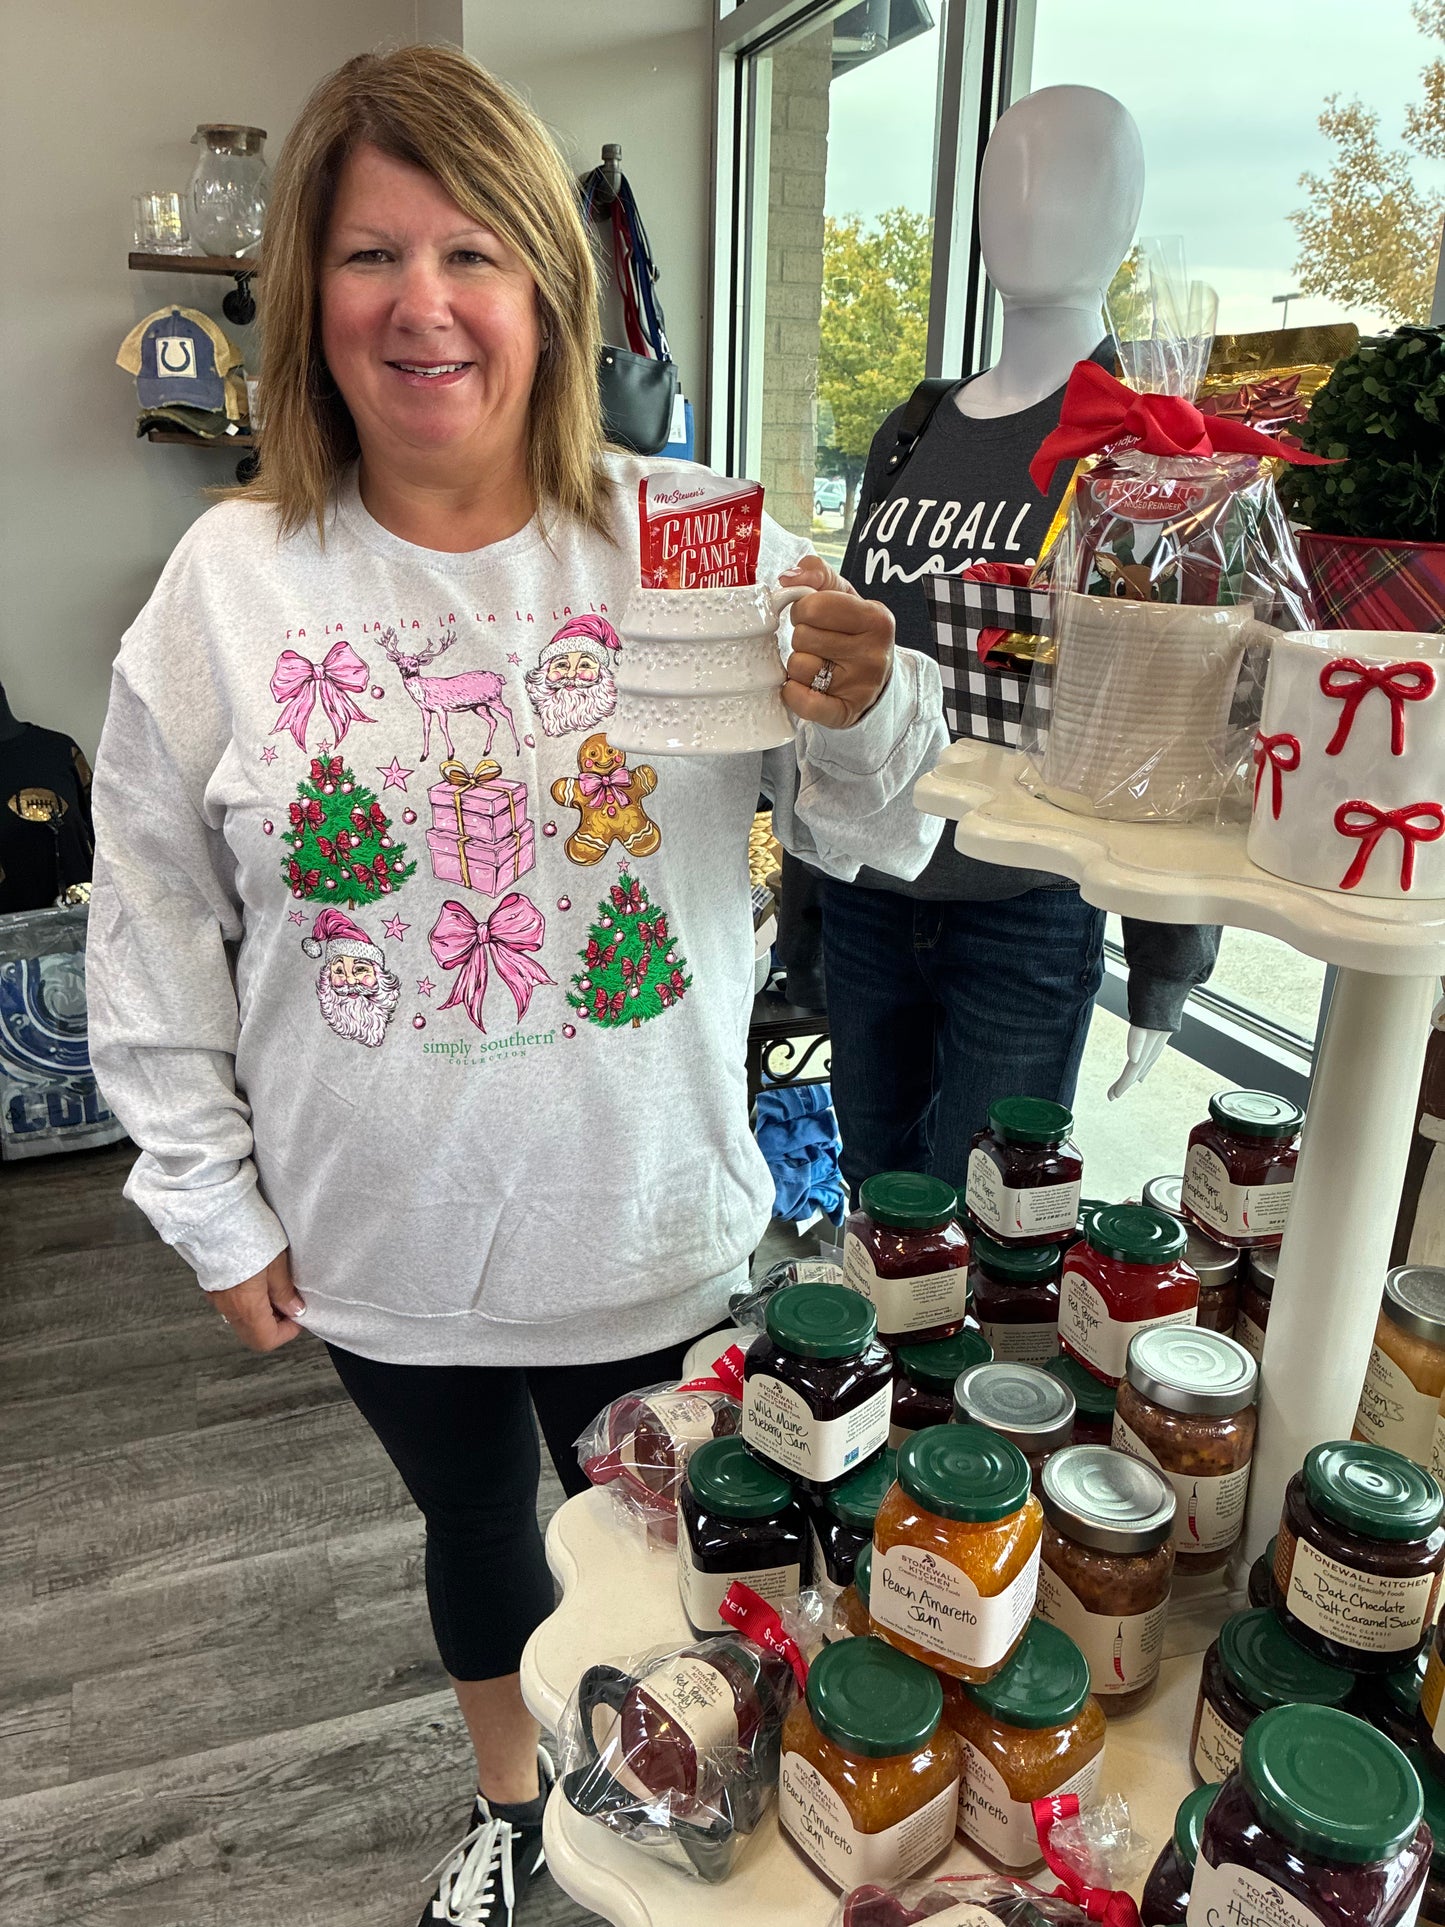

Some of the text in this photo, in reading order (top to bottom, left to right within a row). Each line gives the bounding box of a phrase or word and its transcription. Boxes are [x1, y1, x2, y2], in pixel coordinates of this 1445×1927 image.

[654, 487, 705, 504] McSteven's
[662, 508, 734, 560] CANDY
[680, 540, 736, 589] CANE
[286, 602, 608, 639] FA LA LA LA LA LA LA LA LA
[423, 1039, 472, 1058] simply
[449, 1050, 527, 1065] COLLECTION
[758, 1382, 799, 1408] STONEWALL
[764, 1390, 793, 1411] KITCHEN
[1363, 1384, 1388, 1410] acon
[754, 1400, 808, 1437] Wild Maine
[1360, 1402, 1384, 1428] ueso
[748, 1409, 812, 1456] Blueberry Jam
[901, 1554, 960, 1584] STONEWALL
[908, 1566, 950, 1587] KITCHEN
[1303, 1544, 1428, 1588] STONEWALL KITCHEN
[882, 1568, 977, 1626] Peach Amaretto
[1294, 1576, 1421, 1629] Sea Salt Caramel Sauce
[1314, 1572, 1406, 1614] Dark Chocolate
[1358, 1586, 1386, 1596] Specialty
[908, 1605, 942, 1632] Jam
[1318, 1612, 1392, 1637] COMPANY CLASSIC
[1332, 1626, 1357, 1638] GLUTEN
[931, 1635, 944, 1645] FREE
[673, 1673, 714, 1708] Red Pepper
[692, 1666, 722, 1696] STONEWALL
[692, 1672, 716, 1695] KITCHEN
[672, 1688, 692, 1708] Jelly
[1208, 1706, 1242, 1744] STONEW
[1214, 1756, 1230, 1778] Sal
[796, 1762, 838, 1810] STONEWALL
[800, 1775, 832, 1810] KITCHEN
[960, 1776, 1008, 1824] Amaretto
[783, 1770, 806, 1812] Peach
[808, 1804, 852, 1855] Amaretto
[958, 1797, 978, 1820] am
[800, 1814, 825, 1850] Jam
[1246, 1892, 1297, 1927] KITCHE
